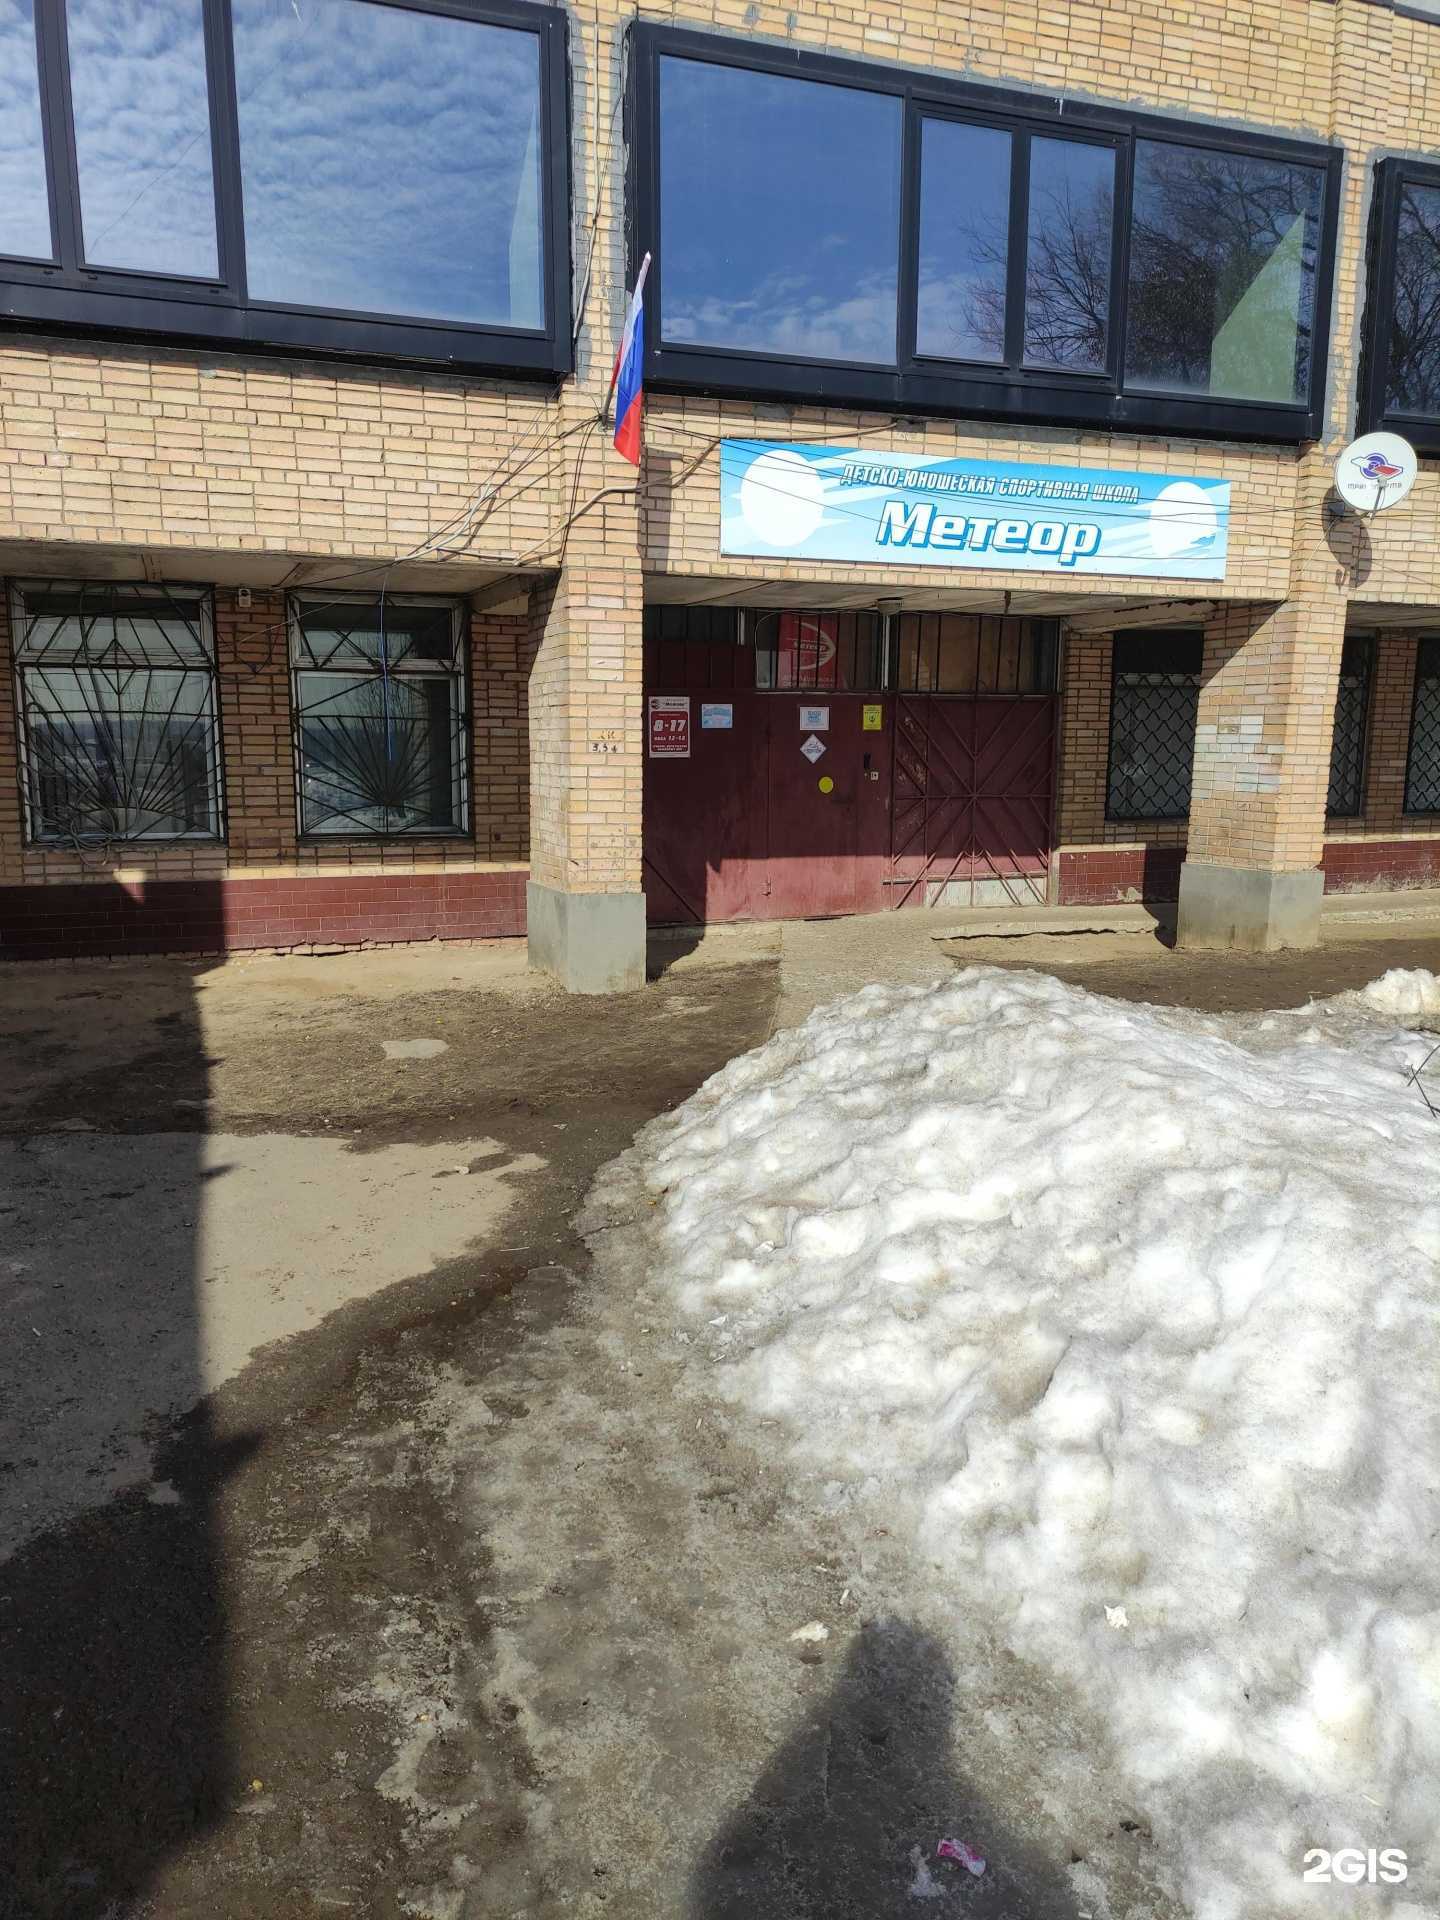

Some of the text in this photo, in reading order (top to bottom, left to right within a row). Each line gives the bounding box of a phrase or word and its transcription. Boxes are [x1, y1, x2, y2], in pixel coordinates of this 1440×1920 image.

[840, 463, 1139, 504] ДЕТСКО-ЮНОШЕСКАЯ СПОРТИВНАЯ ШКОЛА
[876, 500, 1101, 566] Метеор
